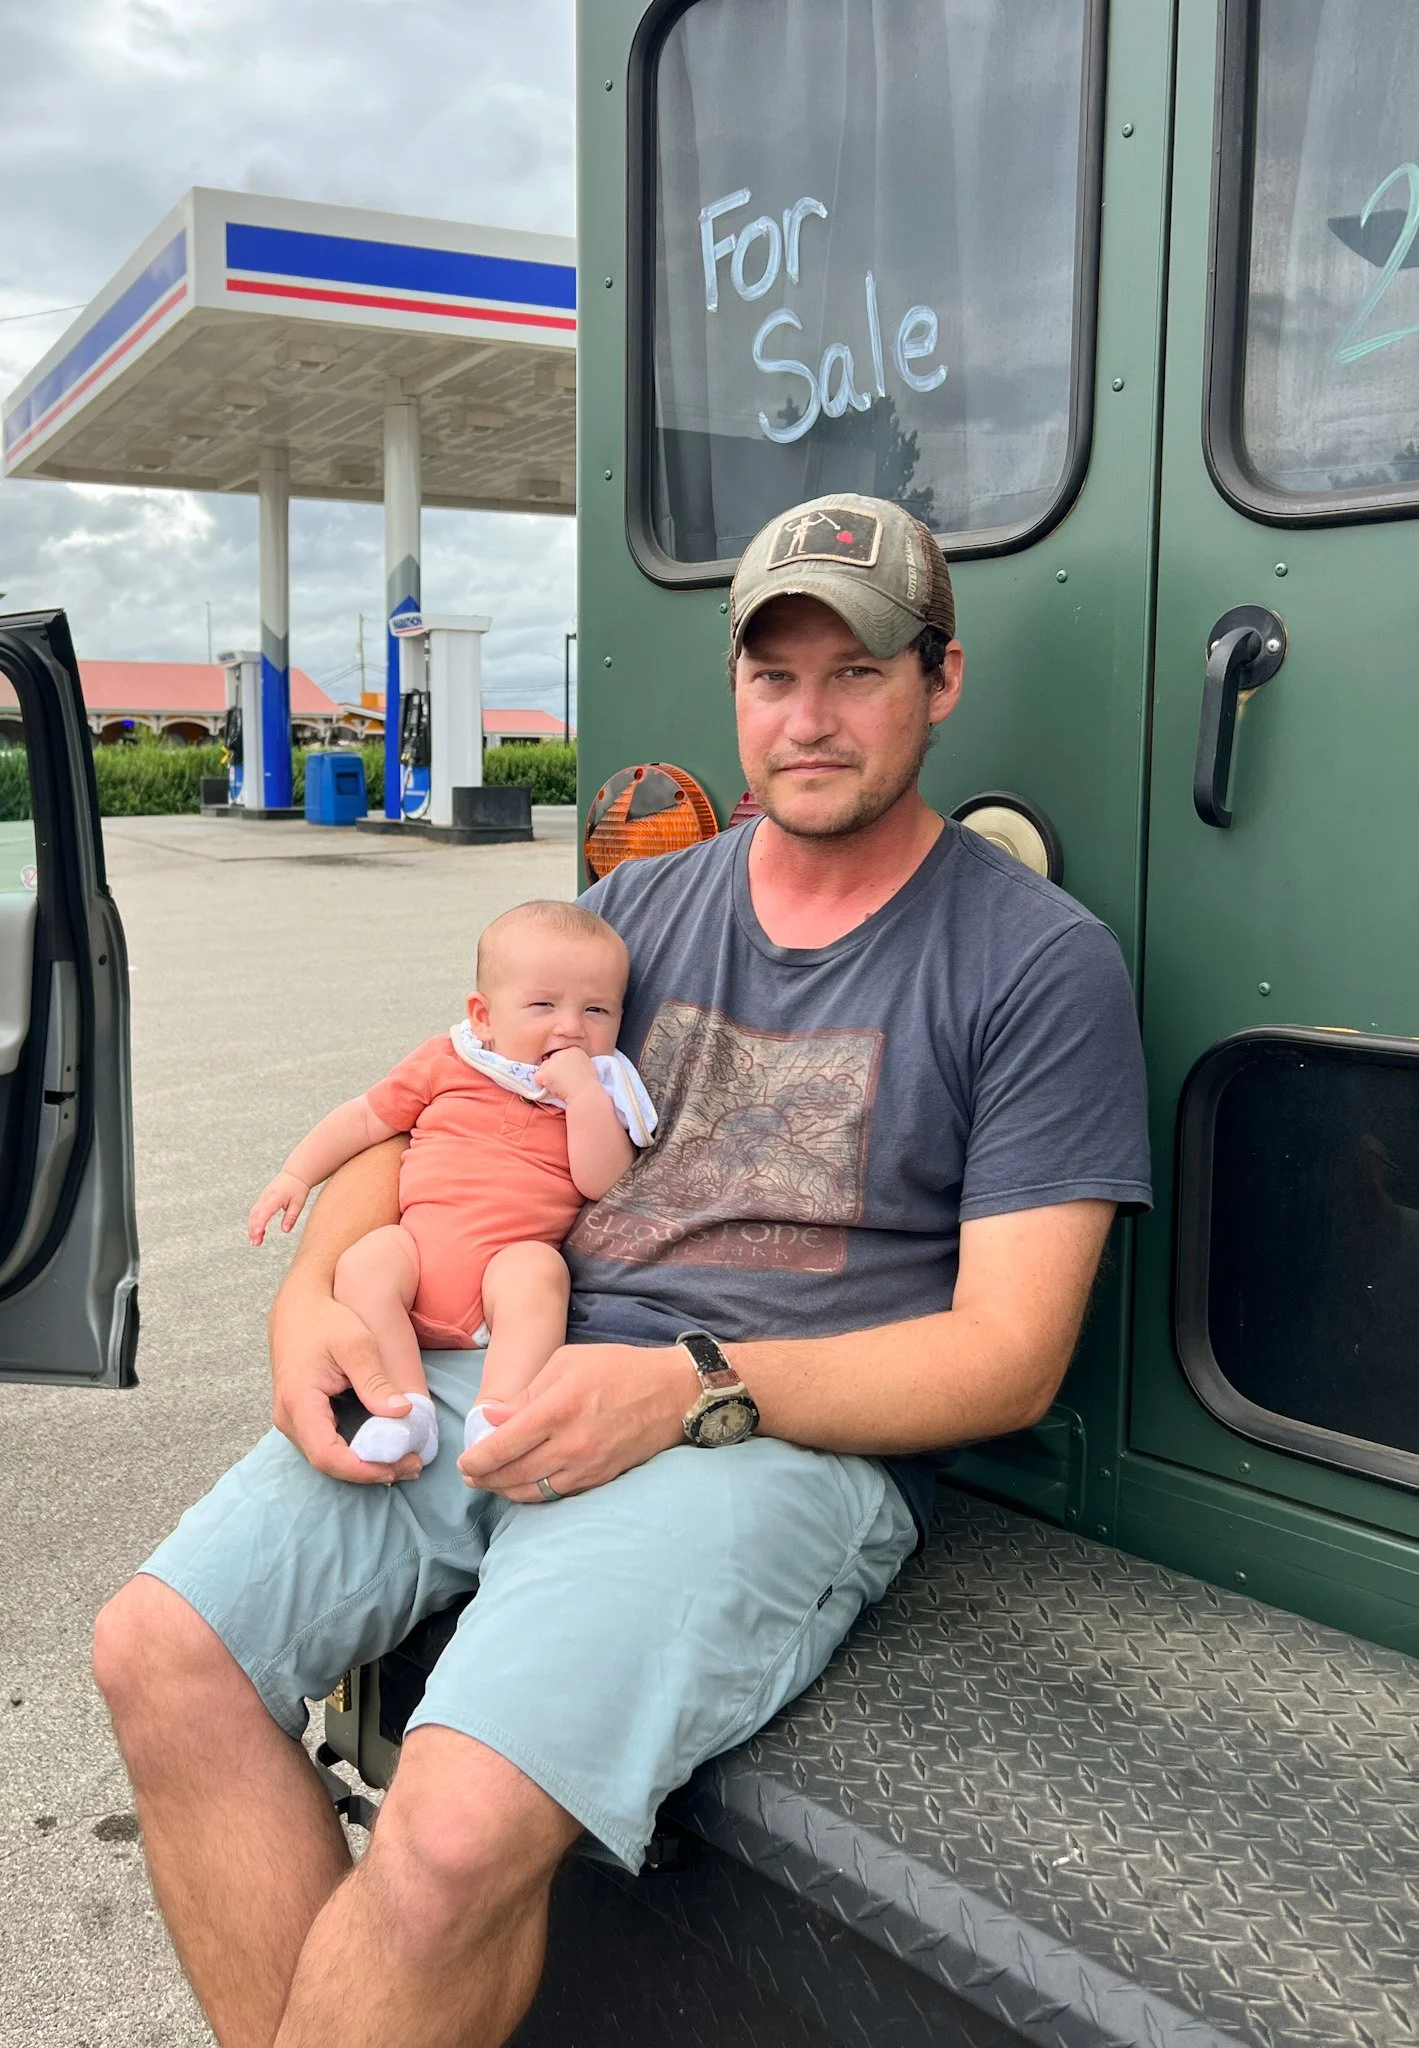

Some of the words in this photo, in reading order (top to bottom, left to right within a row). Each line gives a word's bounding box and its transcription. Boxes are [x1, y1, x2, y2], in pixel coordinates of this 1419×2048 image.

[698, 187, 828, 313] For
[752, 269, 948, 444] Sale
[906, 566, 917, 600] OUTER
[585, 1208, 824, 1248] ELLOWSTONE
